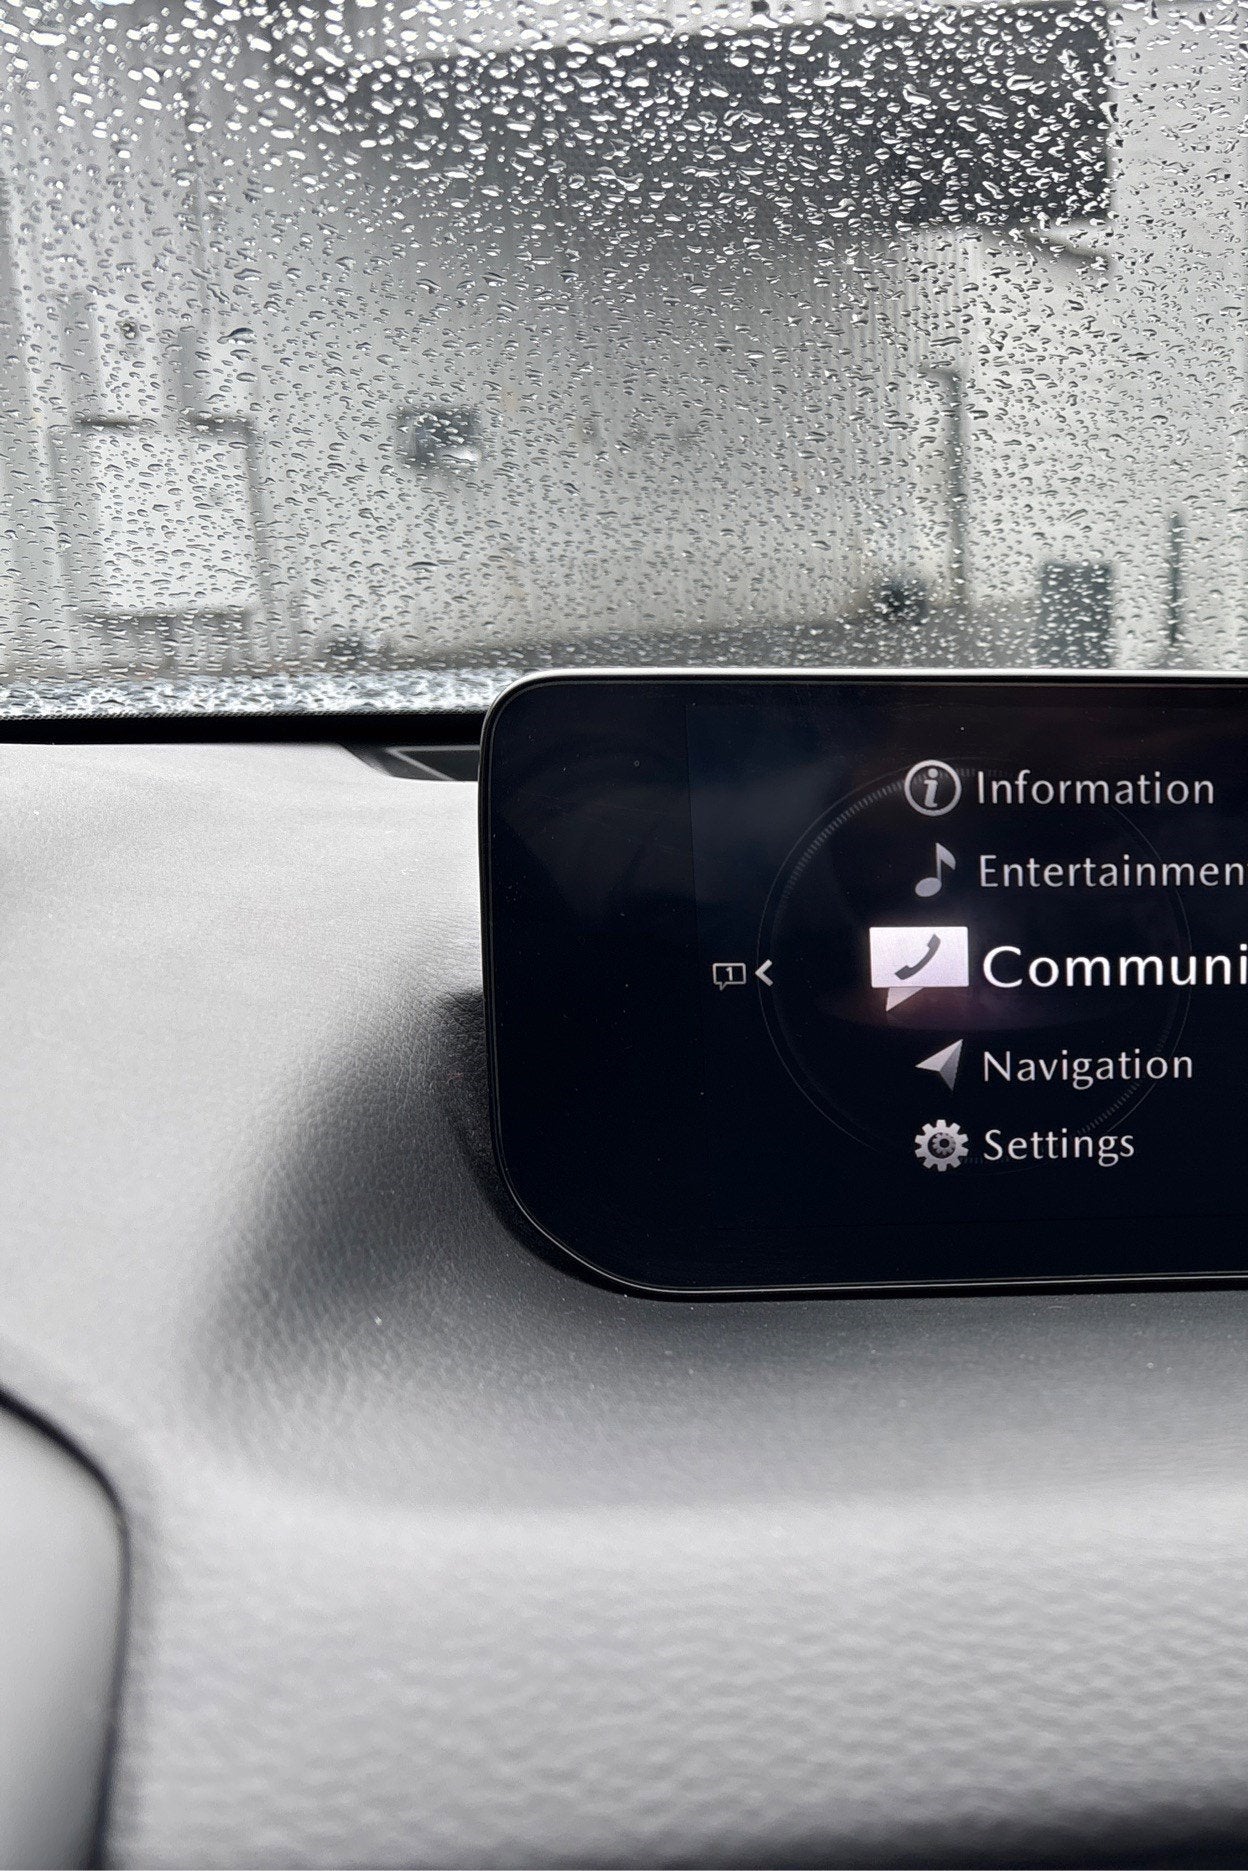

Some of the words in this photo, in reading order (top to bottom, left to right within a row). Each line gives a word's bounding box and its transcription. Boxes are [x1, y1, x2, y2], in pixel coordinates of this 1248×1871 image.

[977, 770, 1215, 805] Information
[983, 1048, 1193, 1090] Navigation
[983, 1127, 1136, 1167] Settings
